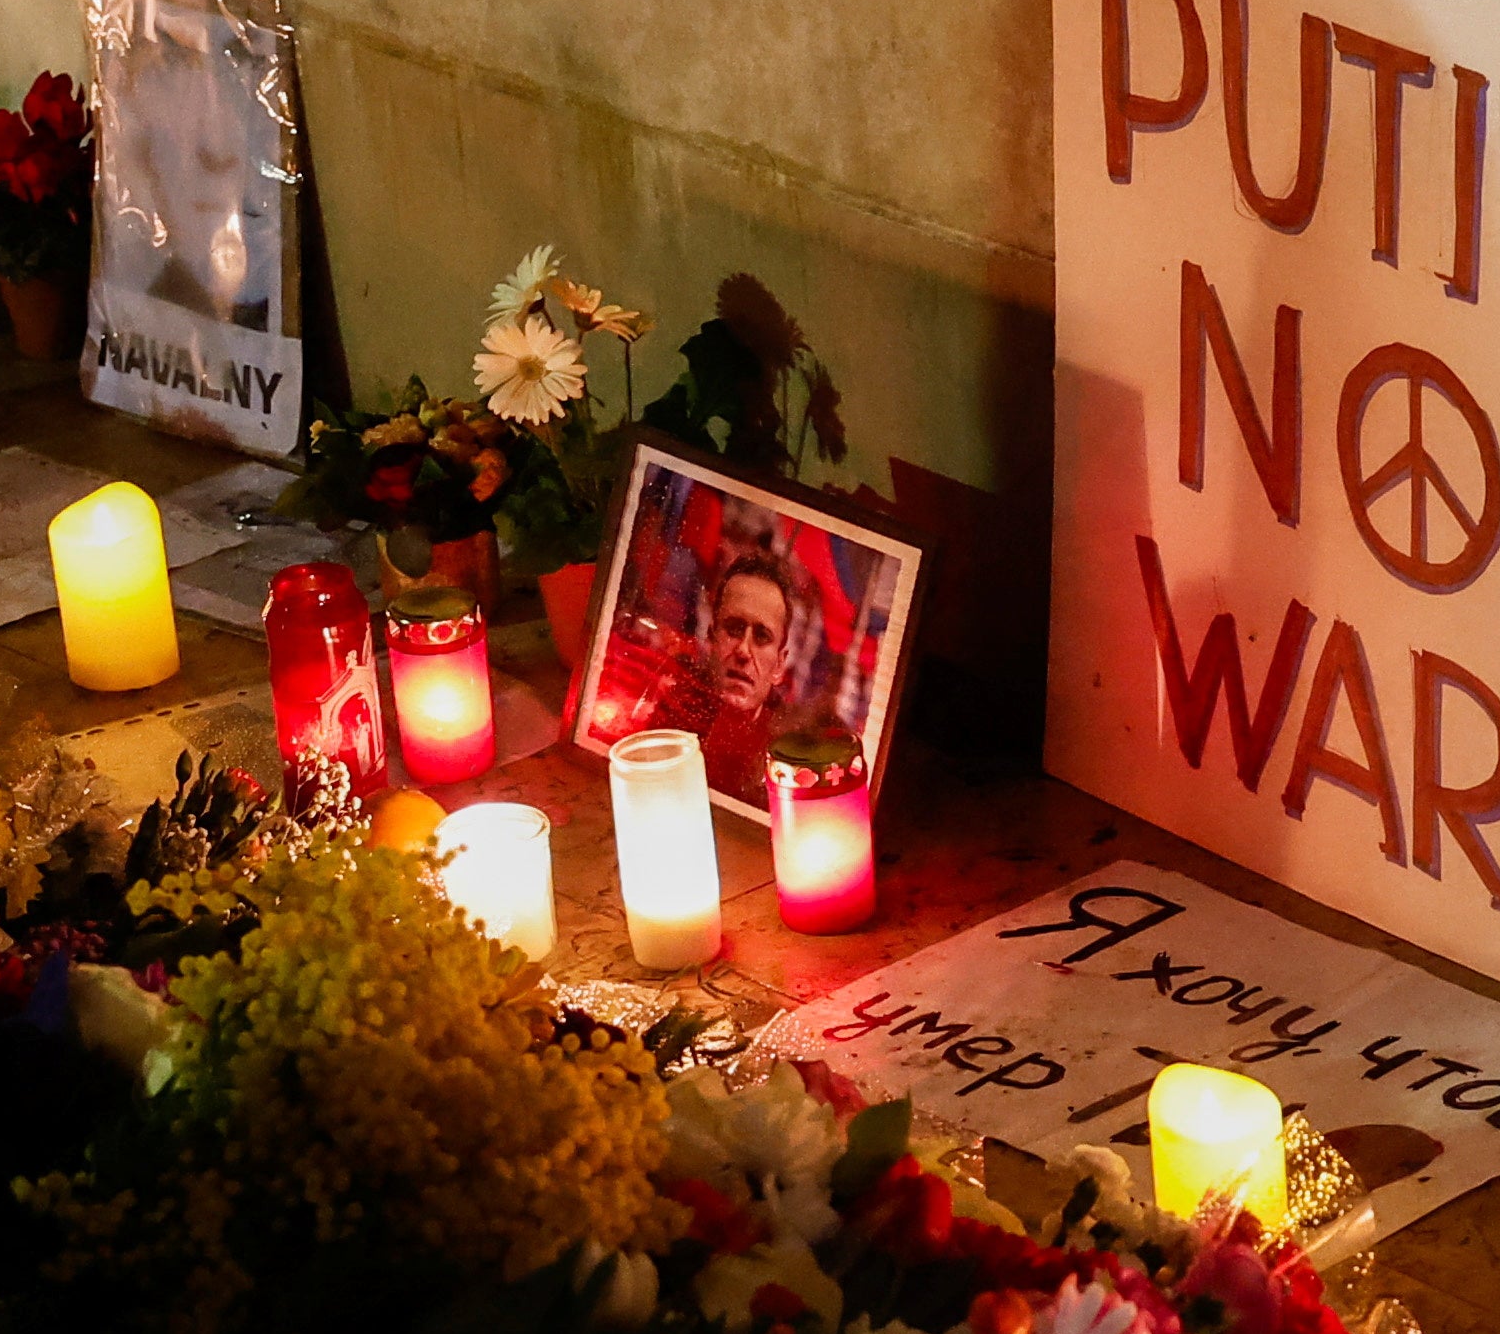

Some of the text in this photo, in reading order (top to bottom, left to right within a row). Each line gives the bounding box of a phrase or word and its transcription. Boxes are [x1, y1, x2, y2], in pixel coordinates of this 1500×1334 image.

[97, 329, 285, 415] NAVALNY
[995, 883, 1190, 967] Я
[1109, 951, 1344, 1064] хочу,
[822, 989, 1068, 1097] умер
